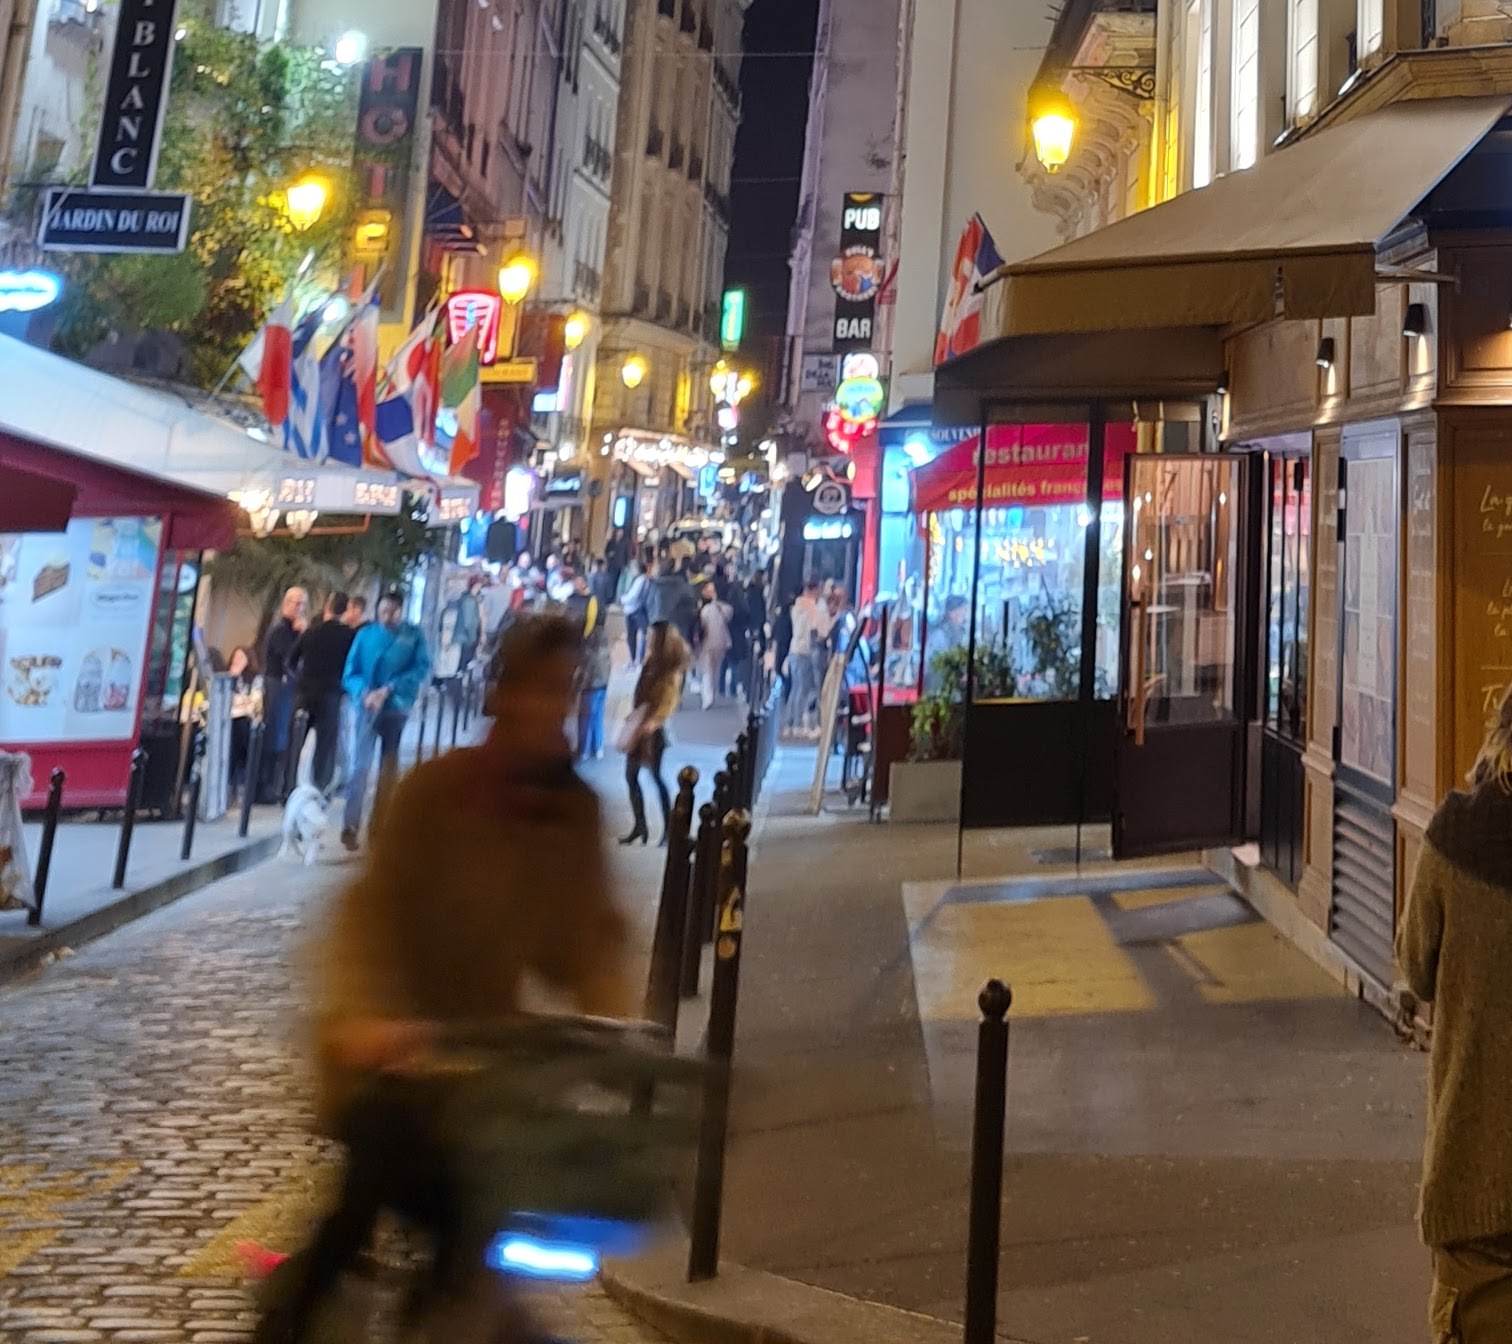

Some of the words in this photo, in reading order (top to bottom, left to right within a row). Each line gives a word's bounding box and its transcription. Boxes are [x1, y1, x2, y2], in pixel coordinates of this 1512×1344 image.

[110, 20, 157, 176] BLANC
[51, 208, 116, 232] JARDIN
[117, 209, 144, 233] DU
[145, 211, 179, 234] ROI
[844, 207, 881, 231] PUB
[836, 318, 872, 339] BAR
[972, 442, 1089, 465] restauran
[947, 480, 1036, 503] spéialités
[1480, 484, 1503, 513] La
